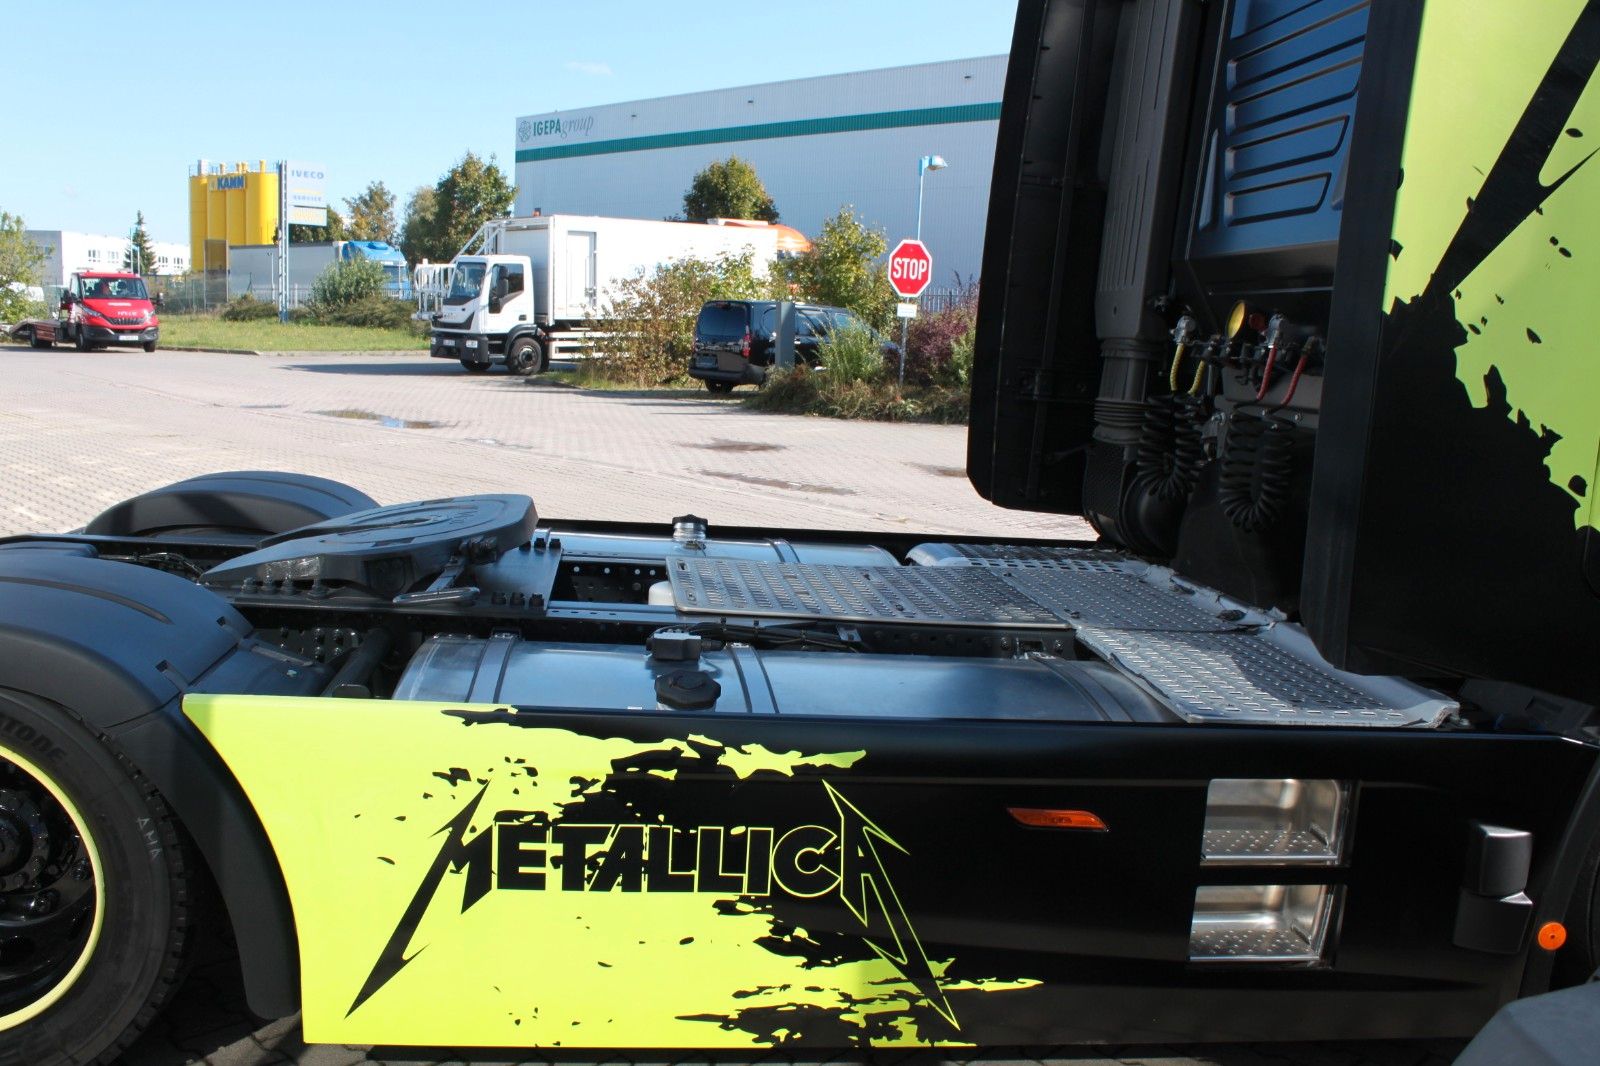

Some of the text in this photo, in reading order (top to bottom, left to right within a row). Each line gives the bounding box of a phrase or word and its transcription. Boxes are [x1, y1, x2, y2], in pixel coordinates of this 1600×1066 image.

[291, 169, 324, 180] IVECO
[893, 257, 928, 281] STOP
[345, 779, 961, 1031] METALLICA
